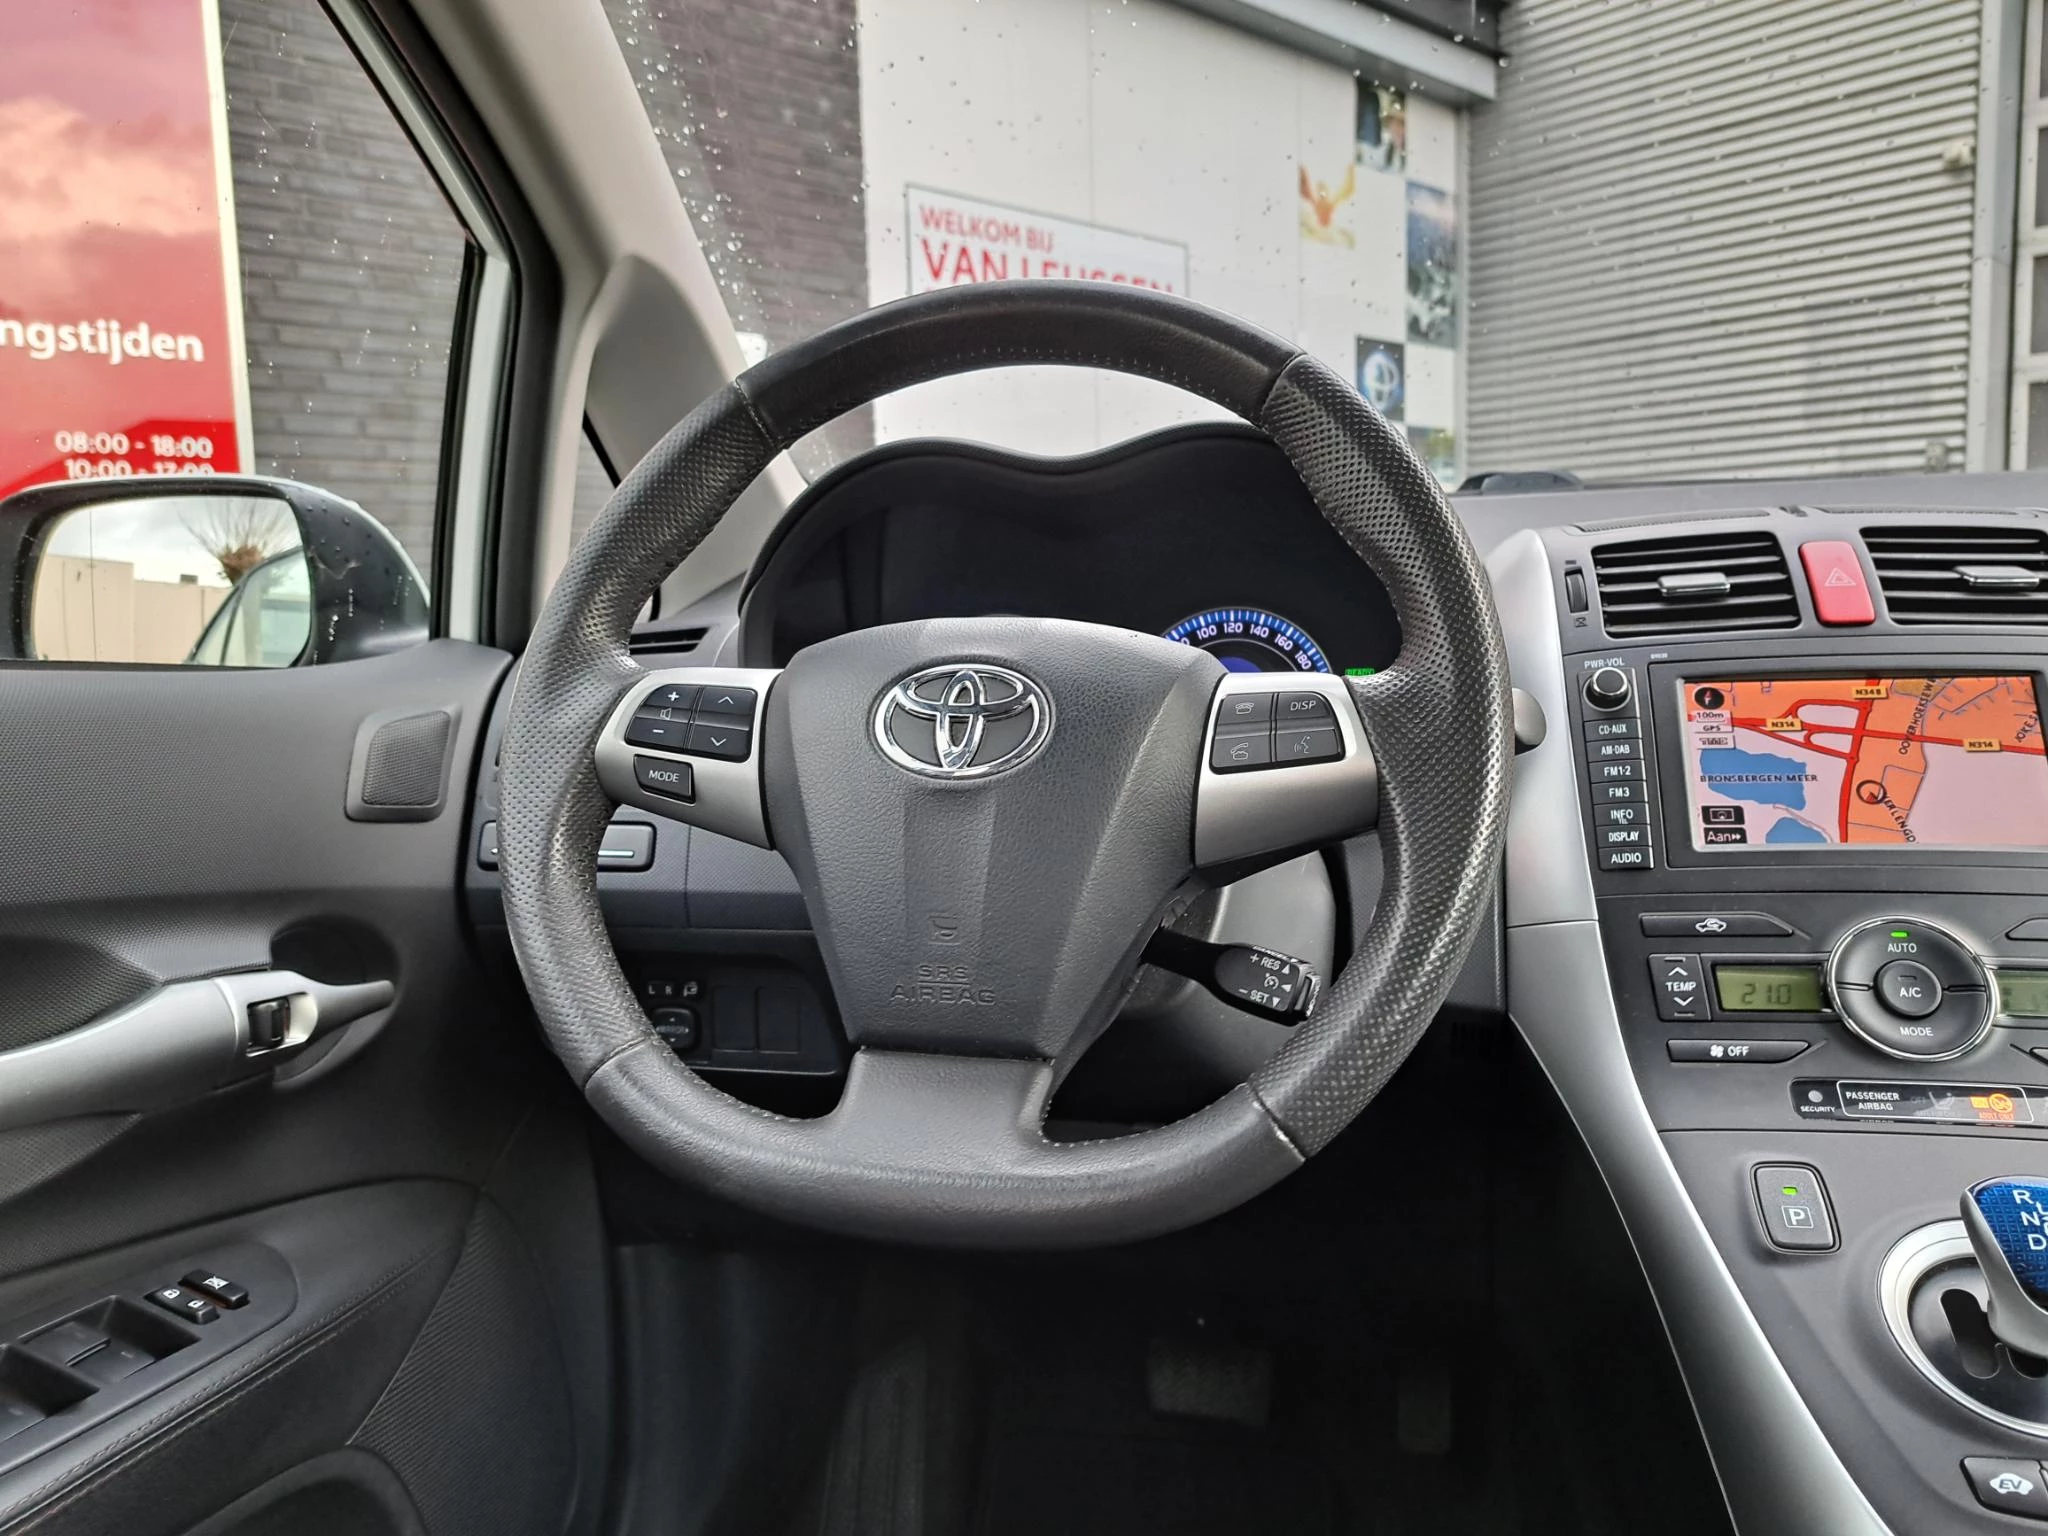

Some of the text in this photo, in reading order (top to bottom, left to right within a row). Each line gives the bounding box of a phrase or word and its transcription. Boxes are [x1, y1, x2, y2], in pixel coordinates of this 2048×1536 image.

[919, 206, 1055, 253] WELKOM BIJ
[920, 238, 1008, 283] VAN
[0, 318, 205, 365] ngstijden
[54, 430, 130, 455] 08:00
[150, 434, 214, 460] 18:00
[64, 457, 133, 479] 10:00
[1196, 624, 1218, 641] 100
[1223, 622, 1244, 633] 120
[1249, 623, 1270, 639] 140
[1273, 633, 1294, 652] 160
[1294, 650, 1313, 671] 180
[1855, 688, 1882, 696] N348
[1289, 700, 1317, 712] DISP
[1696, 711, 1725, 720] 100m
[1771, 720, 1796, 728] N314
[1968, 741, 1994, 749] N314
[648, 770, 680, 783] MODE
[1700, 774, 1819, 783] BRONSBERGEN MEER
[1608, 786, 1630, 798] FM3
[1610, 808, 1634, 820] INFO
[1608, 830, 1640, 843] DISPLAY
[1707, 831, 1732, 842] Aan
[1610, 851, 1642, 864] AUDIO
[1887, 943, 1918, 953] AUTO
[1260, 956, 1282, 971] RES
[918, 964, 969, 981] SRS
[648, 985, 672, 995] L R
[1665, 981, 1697, 992] TEMP
[1899, 987, 1922, 998] A/C
[889, 984, 996, 1006] AIRBAG
[1249, 989, 1270, 1004] SET
[1900, 1026, 1934, 1037] MODE
[1727, 1045, 1750, 1057] OFF
[1845, 1091, 1900, 1102] PASSENGER
[1800, 1105, 1835, 1113] SECURITY
[1857, 1102, 1894, 1112] AIRBAG
[2012, 1189, 2034, 1204] R
[1788, 1208, 1805, 1225] P
[2020, 1211, 2040, 1226] N
[2027, 1234, 2047, 1250] D
[1998, 1478, 2022, 1490] EV
